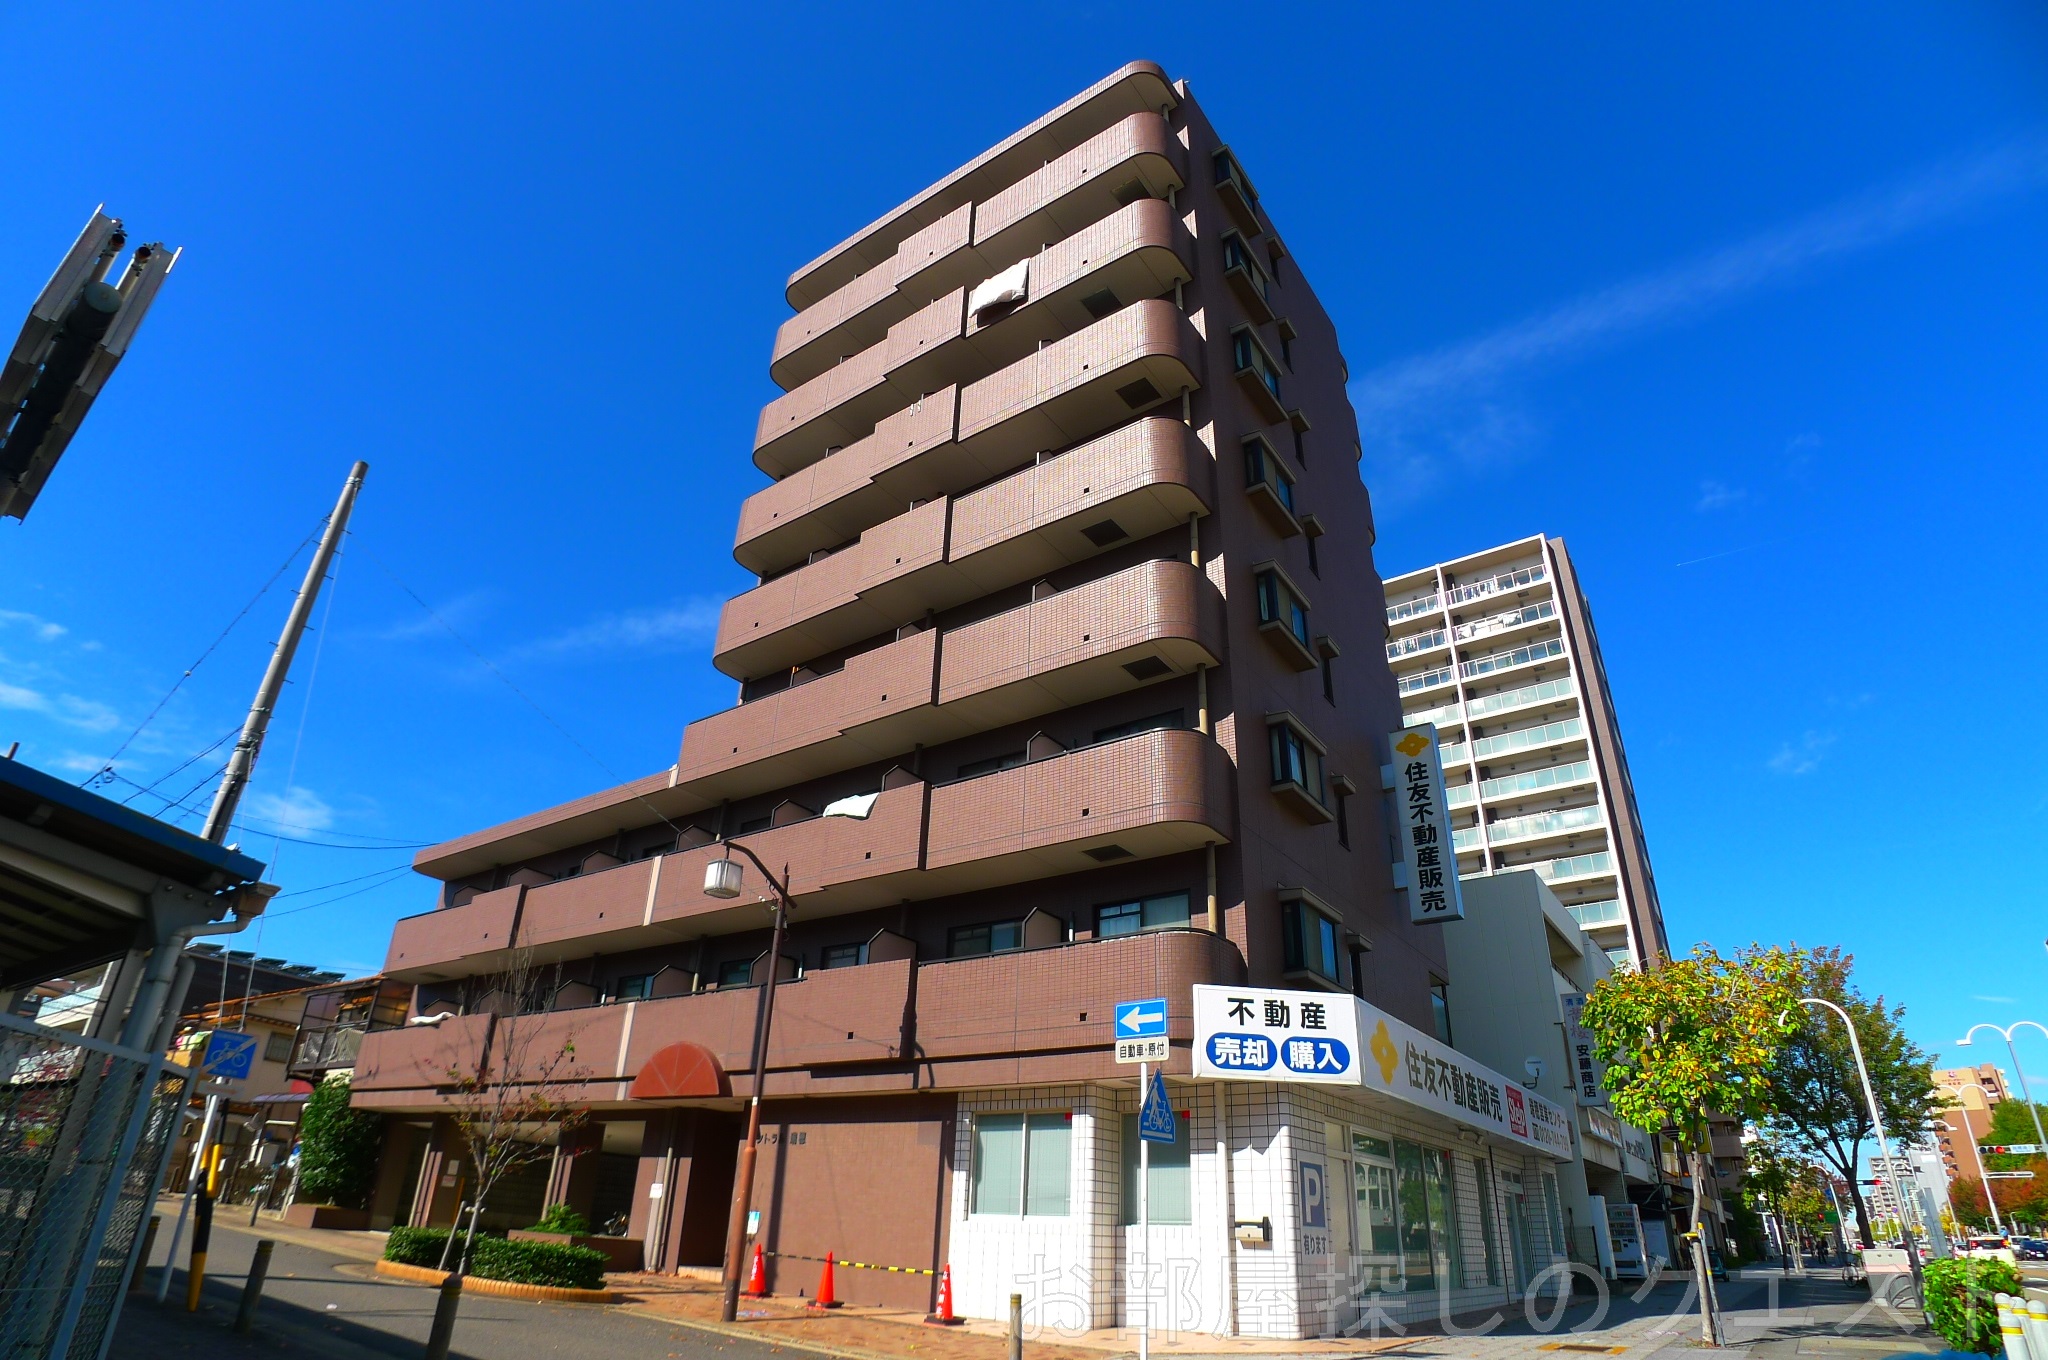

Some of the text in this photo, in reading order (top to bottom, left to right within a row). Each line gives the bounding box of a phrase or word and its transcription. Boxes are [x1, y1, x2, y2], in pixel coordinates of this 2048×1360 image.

[1405, 762, 1447, 913] 住友不動産販売
[1227, 997, 1327, 1030] 不動産
[1214, 1037, 1343, 1071] 売却 購入
[1576, 1044, 1597, 1097] 安藤商店
[1405, 1040, 1502, 1122] 住友不動産販売
[1304, 1167, 1321, 1223] P
[1303, 1234, 1327, 1255] 有ります
